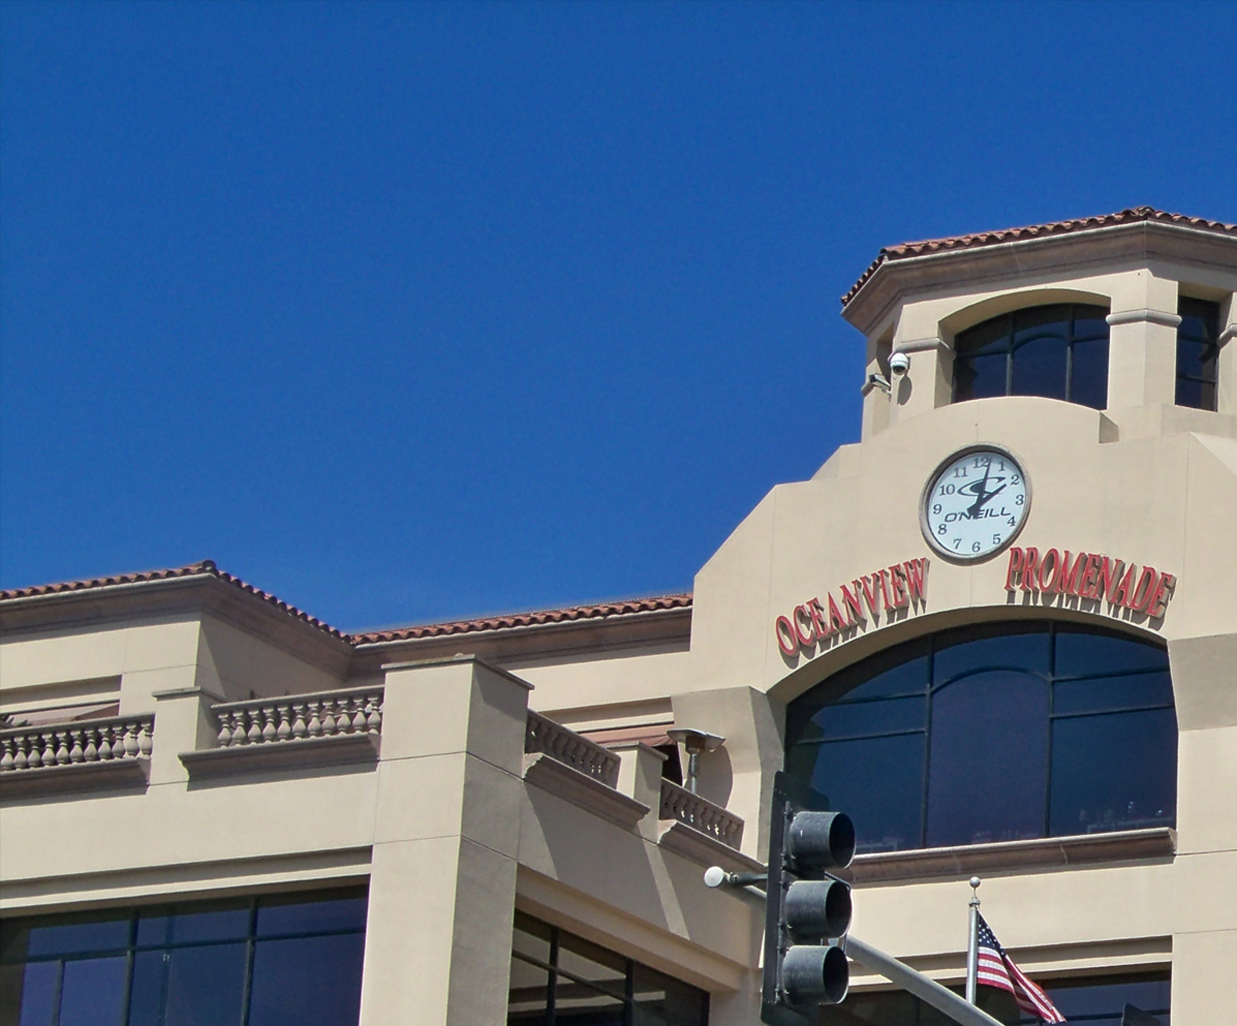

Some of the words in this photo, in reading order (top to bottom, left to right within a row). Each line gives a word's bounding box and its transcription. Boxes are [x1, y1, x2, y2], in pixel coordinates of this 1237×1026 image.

[973, 456, 990, 469] 12
[998, 461, 1007, 472] 1
[953, 466, 968, 478] 11
[1010, 474, 1020, 486] 2
[939, 484, 955, 496] 10
[1015, 494, 1024, 506] 3
[933, 503, 942, 515] 9
[1007, 516, 1016, 527] 4
[938, 523, 947, 535] 8
[953, 538, 962, 549] 7
[992, 534, 1001, 545] 5
[971, 541, 981, 553] 6
[775, 557, 930, 657] OCEANVIEW
[1004, 547, 1177, 619] PROMENADE
